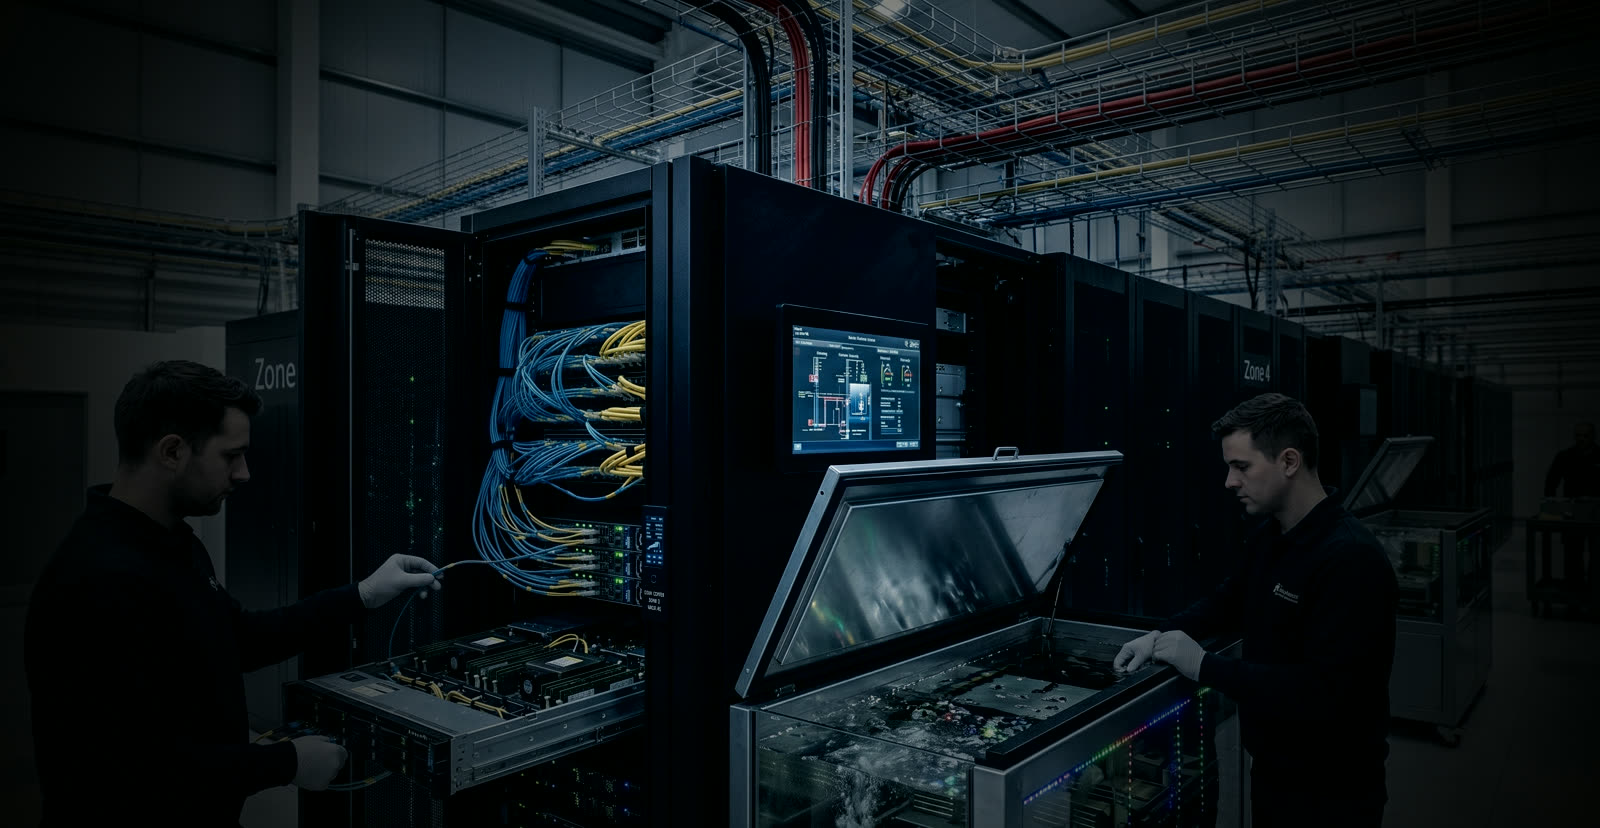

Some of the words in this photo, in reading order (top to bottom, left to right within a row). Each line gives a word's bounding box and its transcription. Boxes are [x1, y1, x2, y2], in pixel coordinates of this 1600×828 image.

[255, 358, 296, 390] Zone
[1244, 360, 1264, 382] Zone
[1265, 364, 1271, 382] 4
